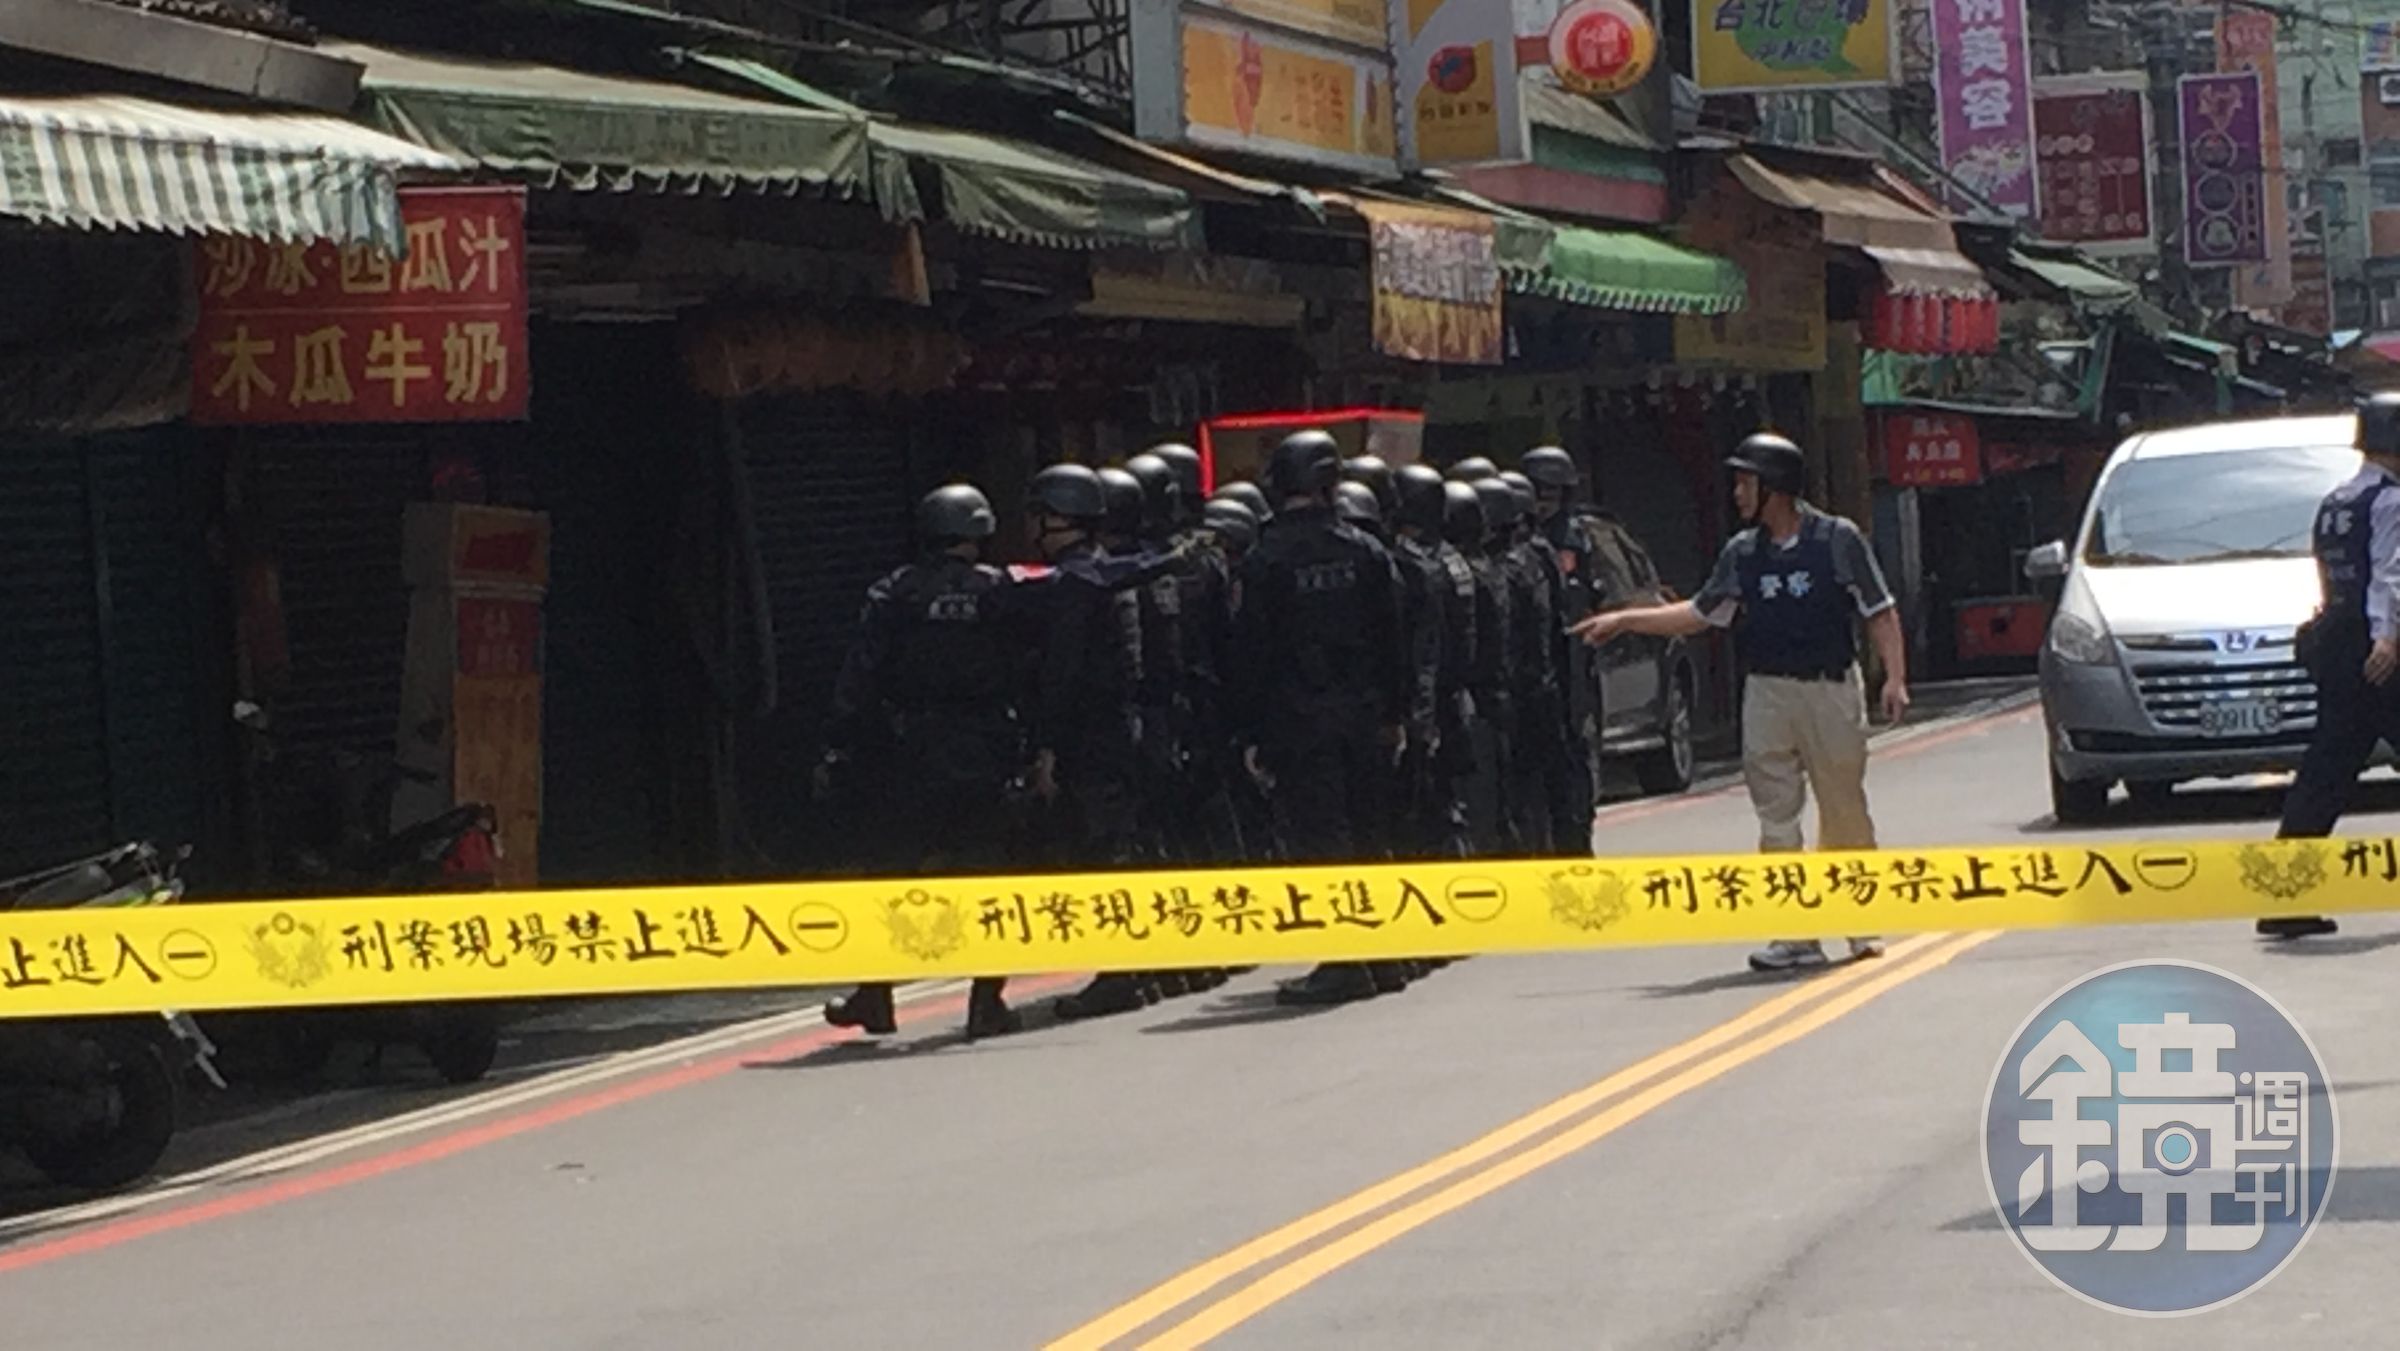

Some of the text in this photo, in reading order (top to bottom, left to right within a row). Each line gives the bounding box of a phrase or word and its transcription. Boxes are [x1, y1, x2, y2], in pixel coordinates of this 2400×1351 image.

[209, 321, 508, 412] 木瓜牛奶
[1643, 849, 2134, 914] 刑案現場禁止進入
[2339, 837, 2398, 882] 刑
[340, 903, 793, 973] 刑案現場禁止進入
[977, 876, 1447, 945] 刑案現場禁止進入
[1, 928, 163, 989] 止進入
